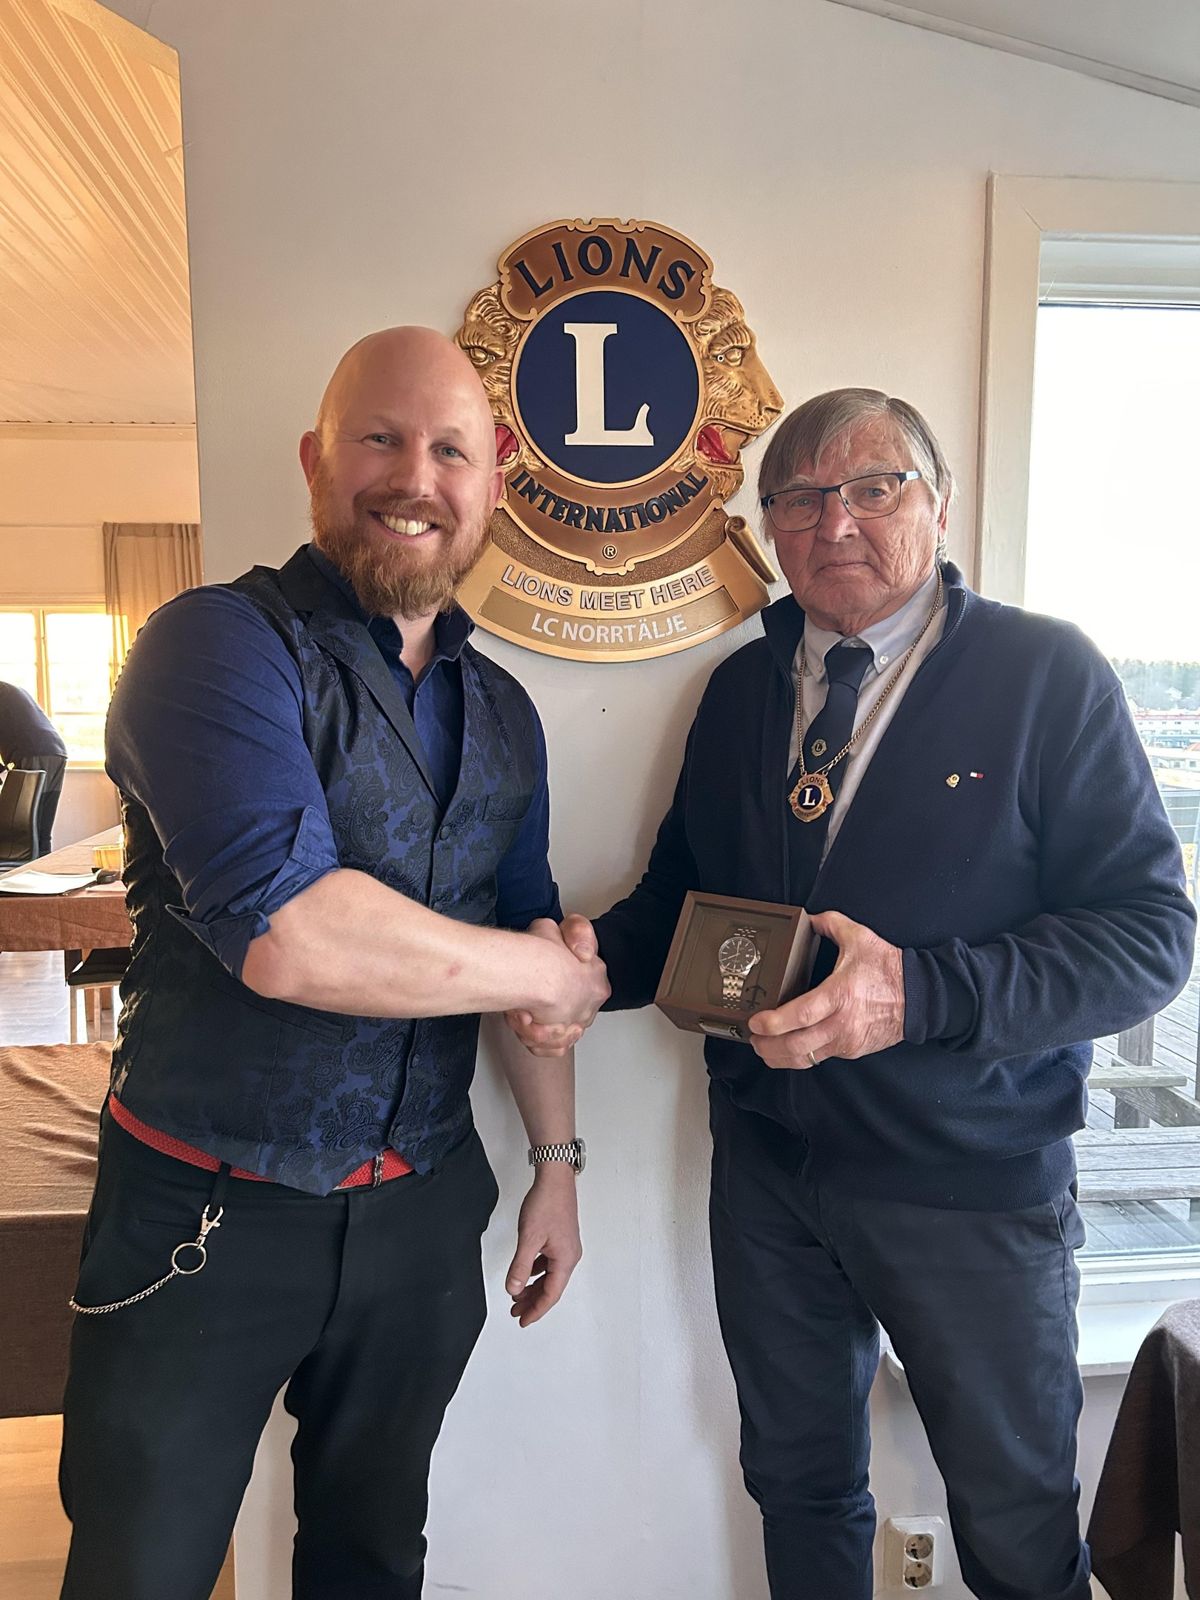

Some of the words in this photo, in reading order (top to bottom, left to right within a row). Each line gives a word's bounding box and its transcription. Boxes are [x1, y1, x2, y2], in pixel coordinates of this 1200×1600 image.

[514, 235, 696, 300] LIONS
[563, 322, 654, 446] L
[509, 469, 709, 533] INTERNATIONAL
[501, 564, 573, 606] LIONS
[579, 588, 645, 611] MEET
[651, 565, 715, 605] HERE
[531, 612, 556, 637] LC
[561, 613, 688, 644] NORRTÄLJE
[802, 788, 816, 806] L
